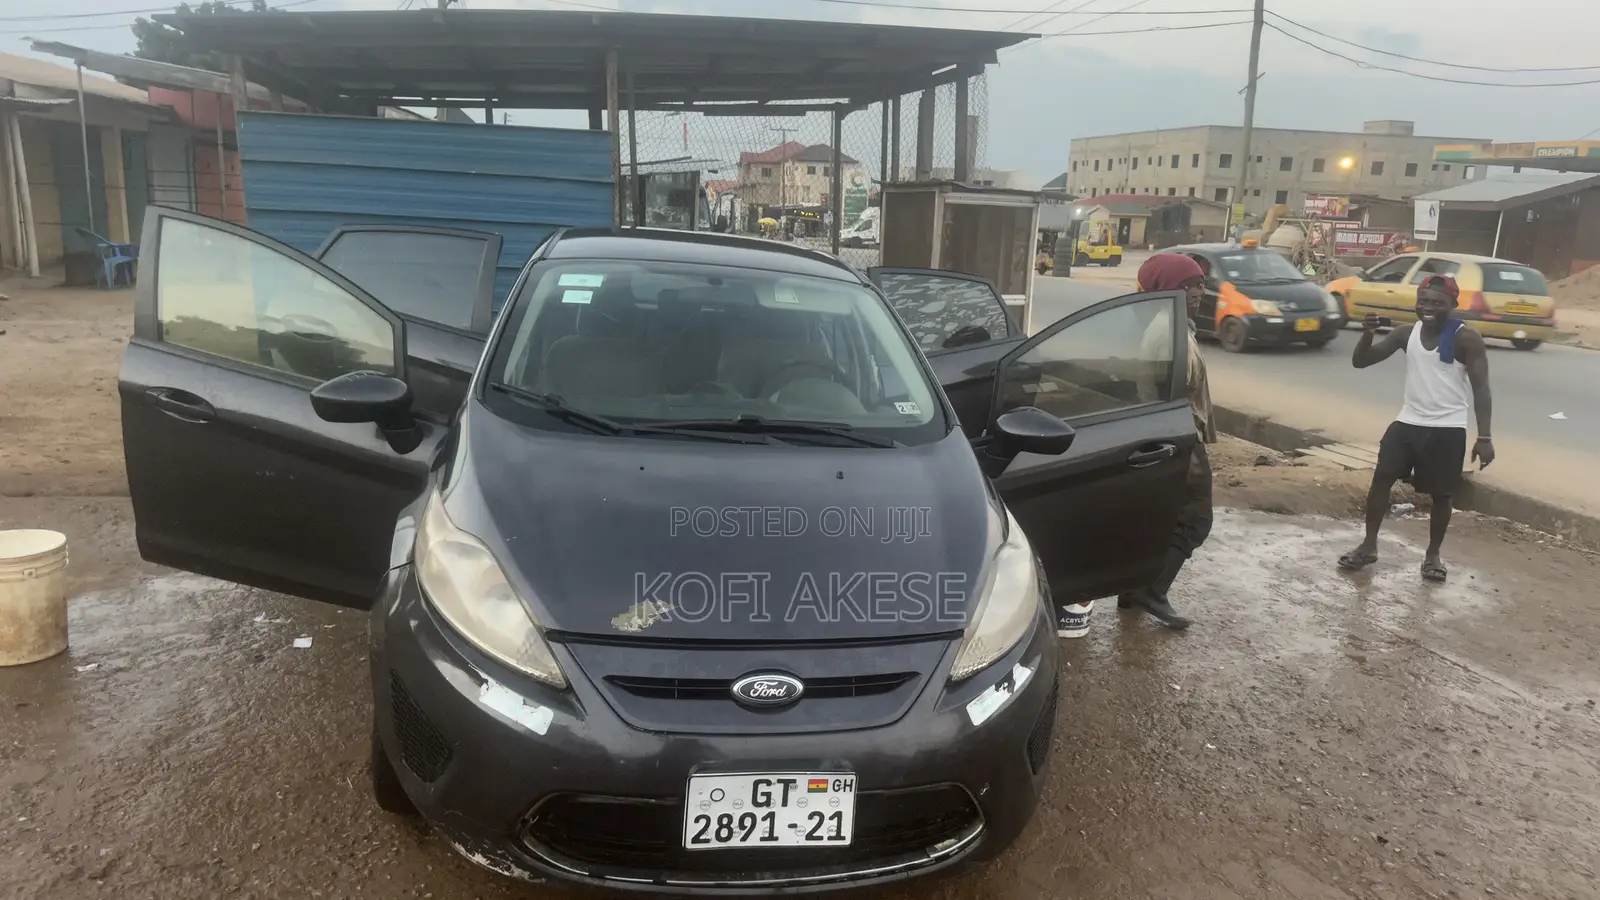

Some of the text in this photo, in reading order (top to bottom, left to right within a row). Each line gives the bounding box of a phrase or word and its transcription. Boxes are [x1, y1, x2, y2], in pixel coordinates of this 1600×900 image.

[750, 681, 788, 697] Ford
[751, 778, 798, 808] GT
[832, 779, 854, 793] GH
